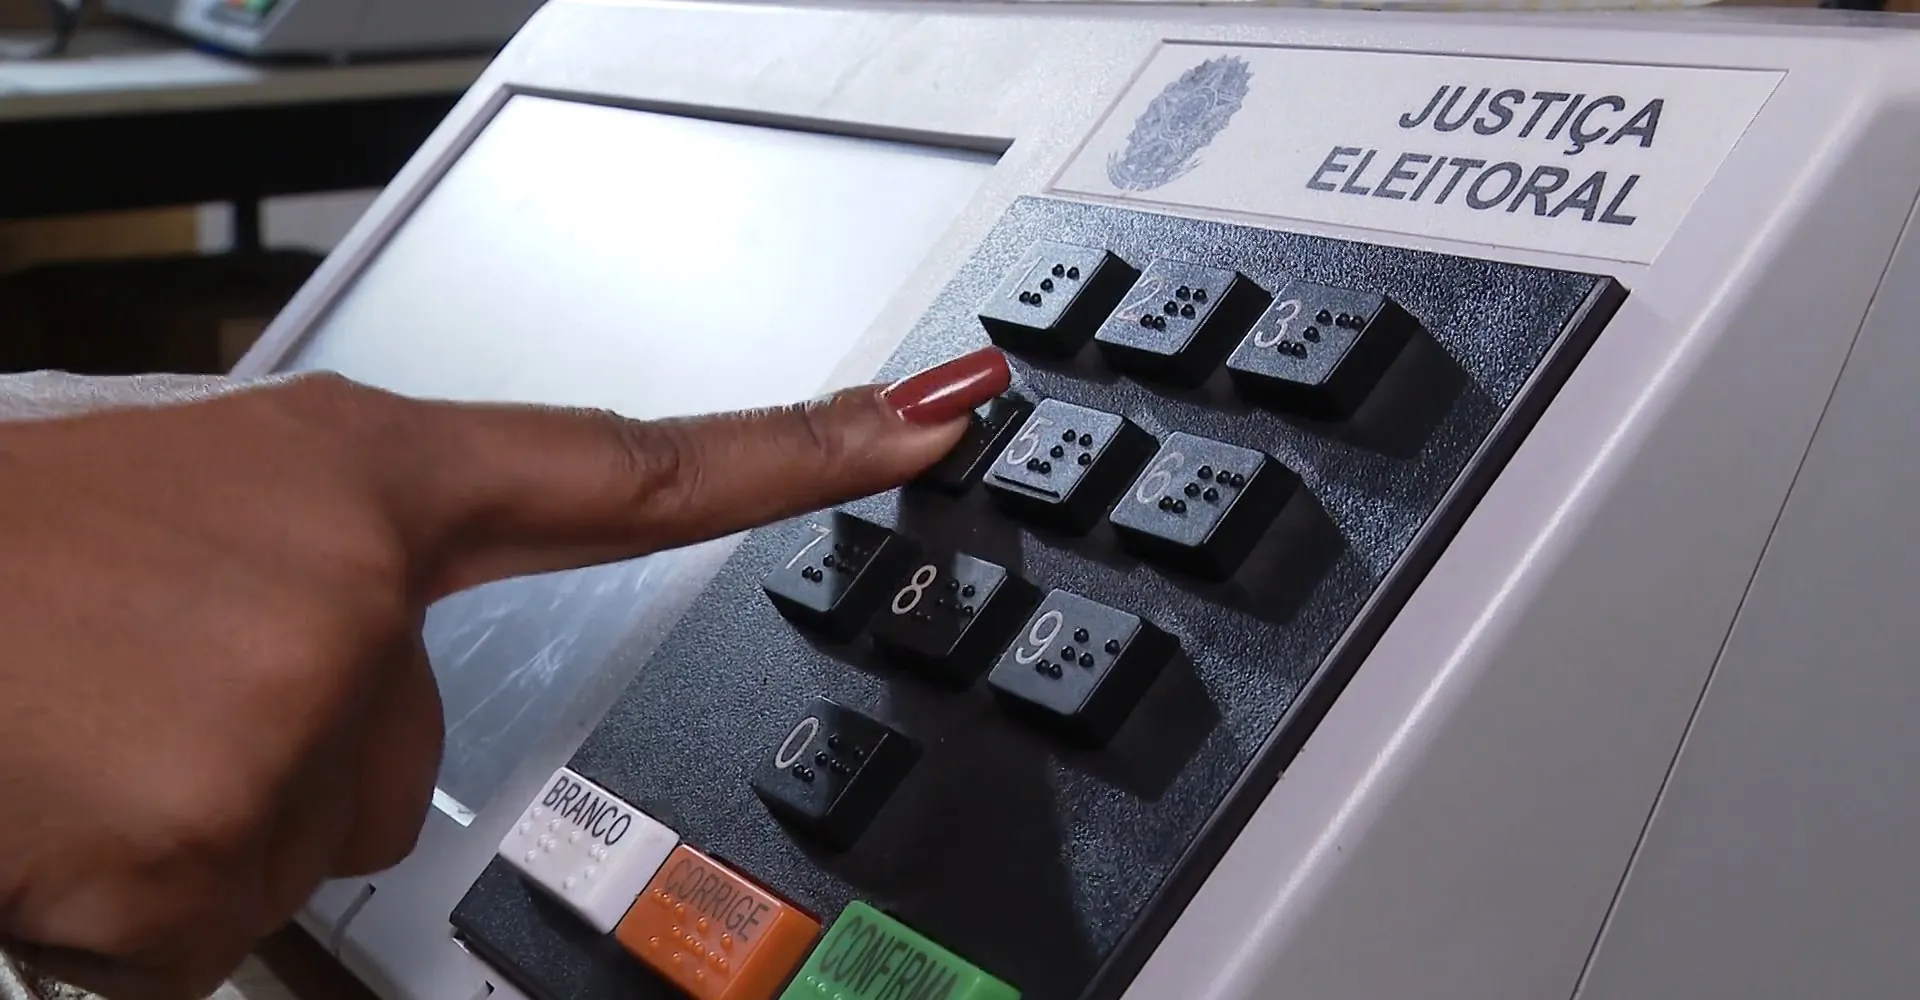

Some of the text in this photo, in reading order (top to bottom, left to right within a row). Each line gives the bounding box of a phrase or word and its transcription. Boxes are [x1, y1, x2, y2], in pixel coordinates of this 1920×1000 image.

[1398, 85, 1665, 155] JUSTIÇA
[1305, 145, 1642, 226] ELEITORAL
[1007, 256, 1044, 299] 1
[1115, 275, 1165, 322] 2
[1253, 300, 1300, 349] 3
[1006, 416, 1053, 465] 5
[1137, 452, 1184, 504] 6
[785, 523, 833, 570] 7
[891, 564, 938, 615] 8
[1014, 609, 1064, 665] 9
[774, 716, 820, 769] 0
[542, 775, 634, 846] BRANCO
[663, 857, 770, 942] CORRIGE
